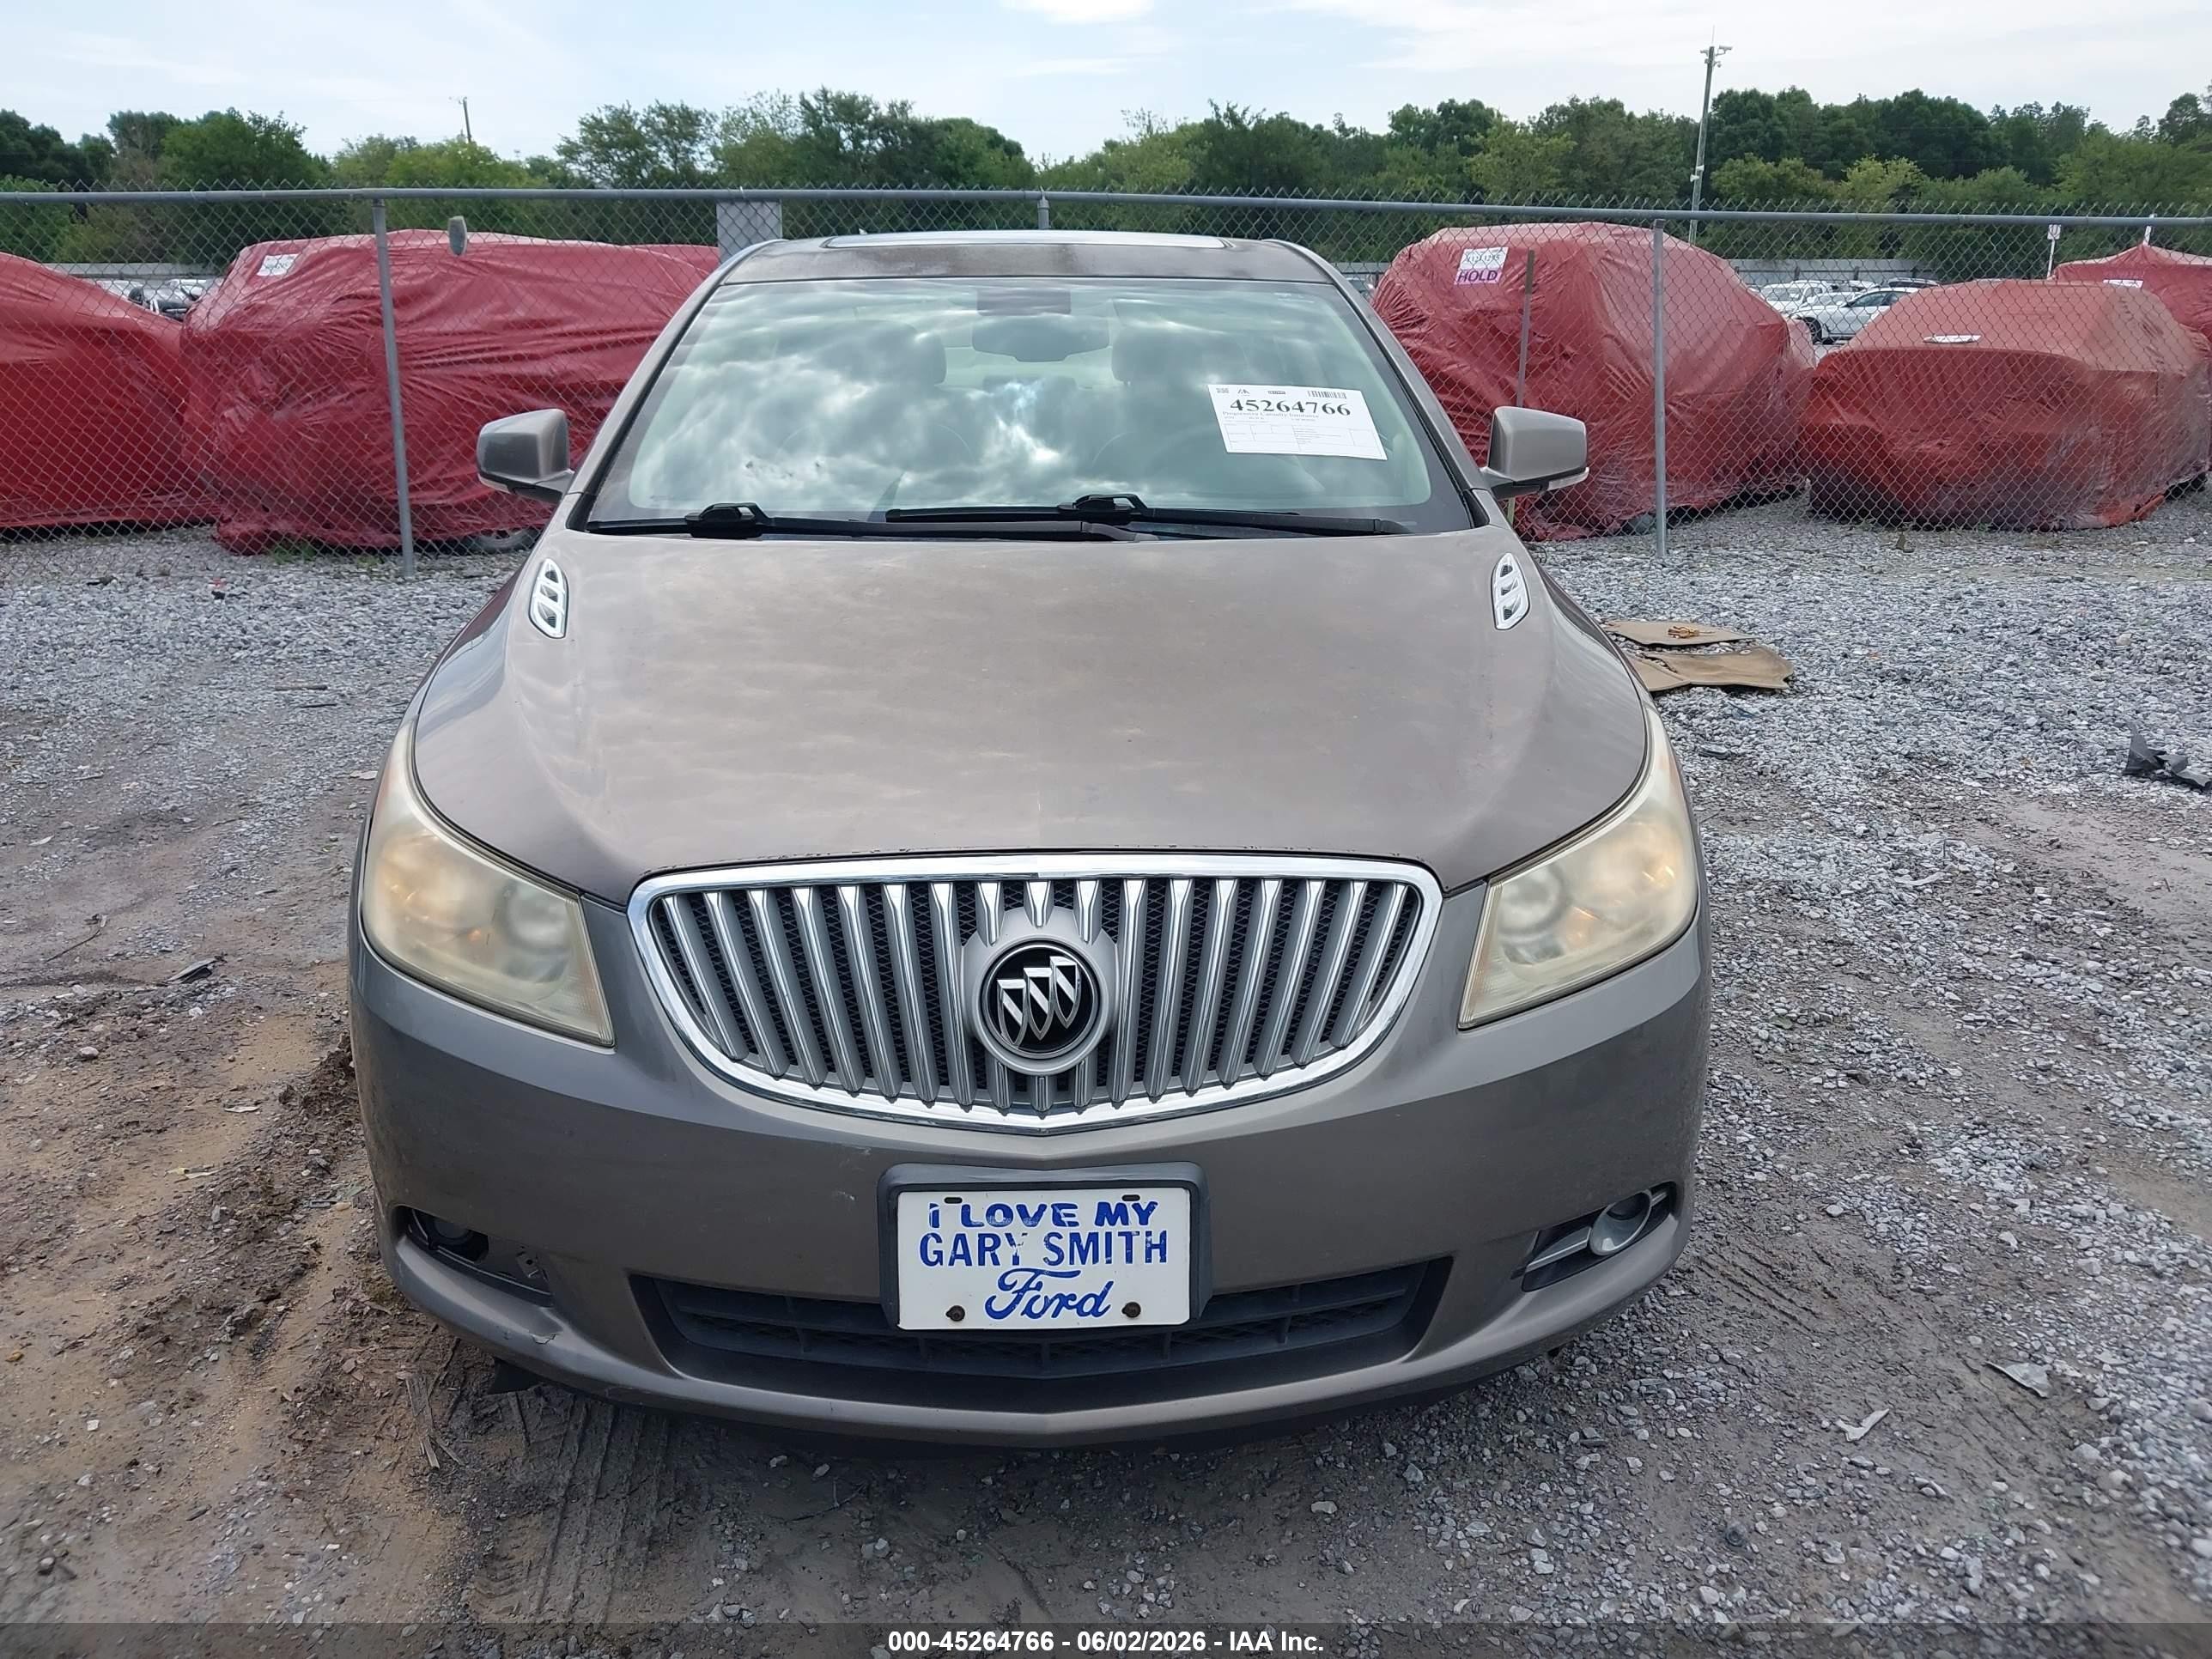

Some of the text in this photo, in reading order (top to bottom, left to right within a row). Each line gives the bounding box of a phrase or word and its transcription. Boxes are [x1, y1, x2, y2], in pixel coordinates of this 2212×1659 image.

[1457, 270, 1498, 283] HOLD
[1230, 398, 1352, 416] 45264766
[960, 1202, 1079, 1228] LOVE
[1094, 1201, 1158, 1226] MY
[1042, 1230, 1167, 1267] SMITH
[984, 1267, 1115, 1320] Ford
